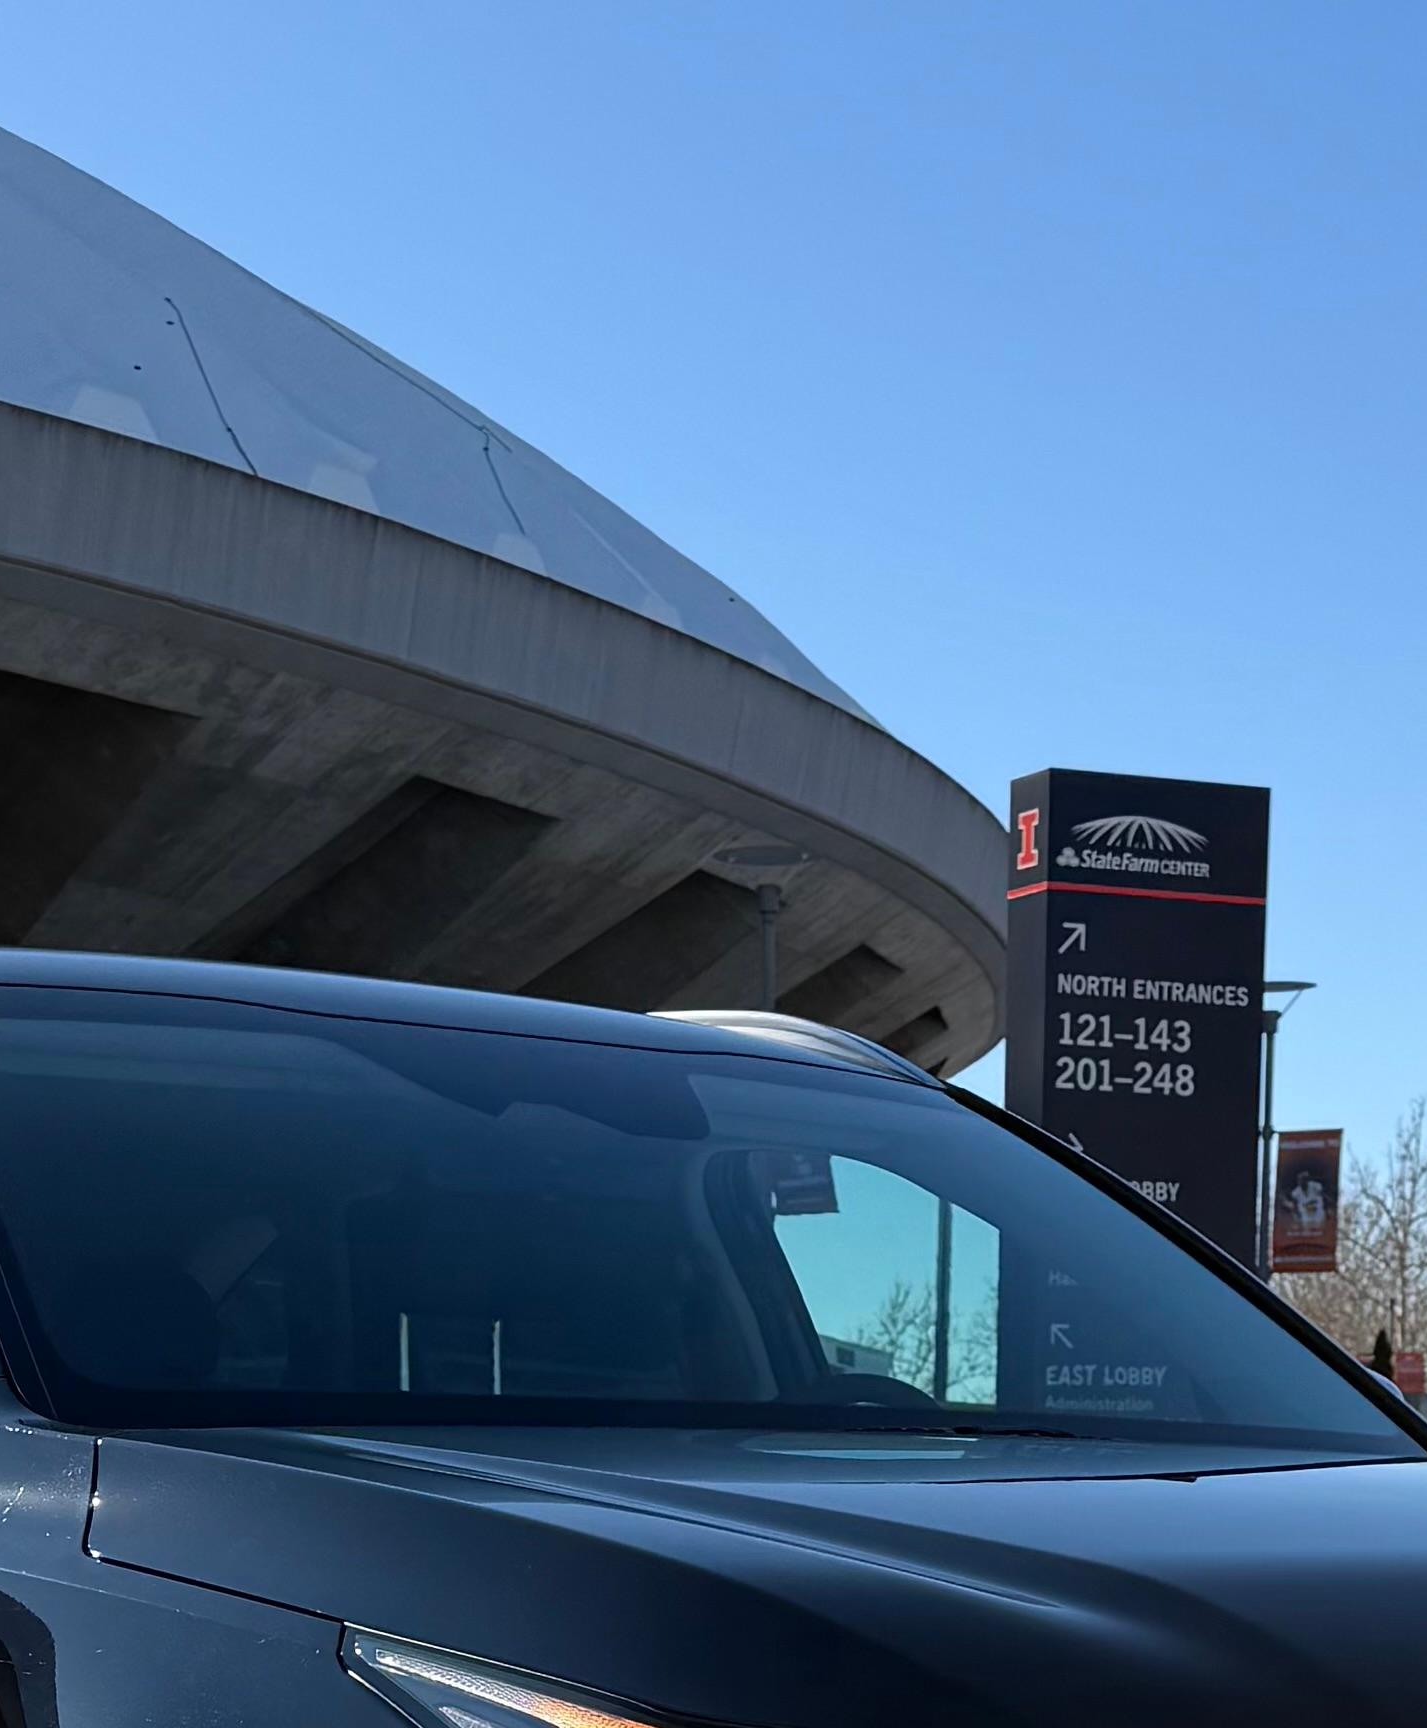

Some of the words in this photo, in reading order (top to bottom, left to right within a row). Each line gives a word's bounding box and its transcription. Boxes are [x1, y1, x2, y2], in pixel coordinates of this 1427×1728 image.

[1016, 807, 1040, 871] I
[1160, 861, 1211, 878] CENTER
[1057, 973, 1126, 998] NORTH
[1133, 979, 1250, 1007] ENTRANCES
[1045, 1364, 1097, 1386] EAST
[1103, 1365, 1168, 1388] LOBBY
[1044, 1394, 1154, 1411] Administration
